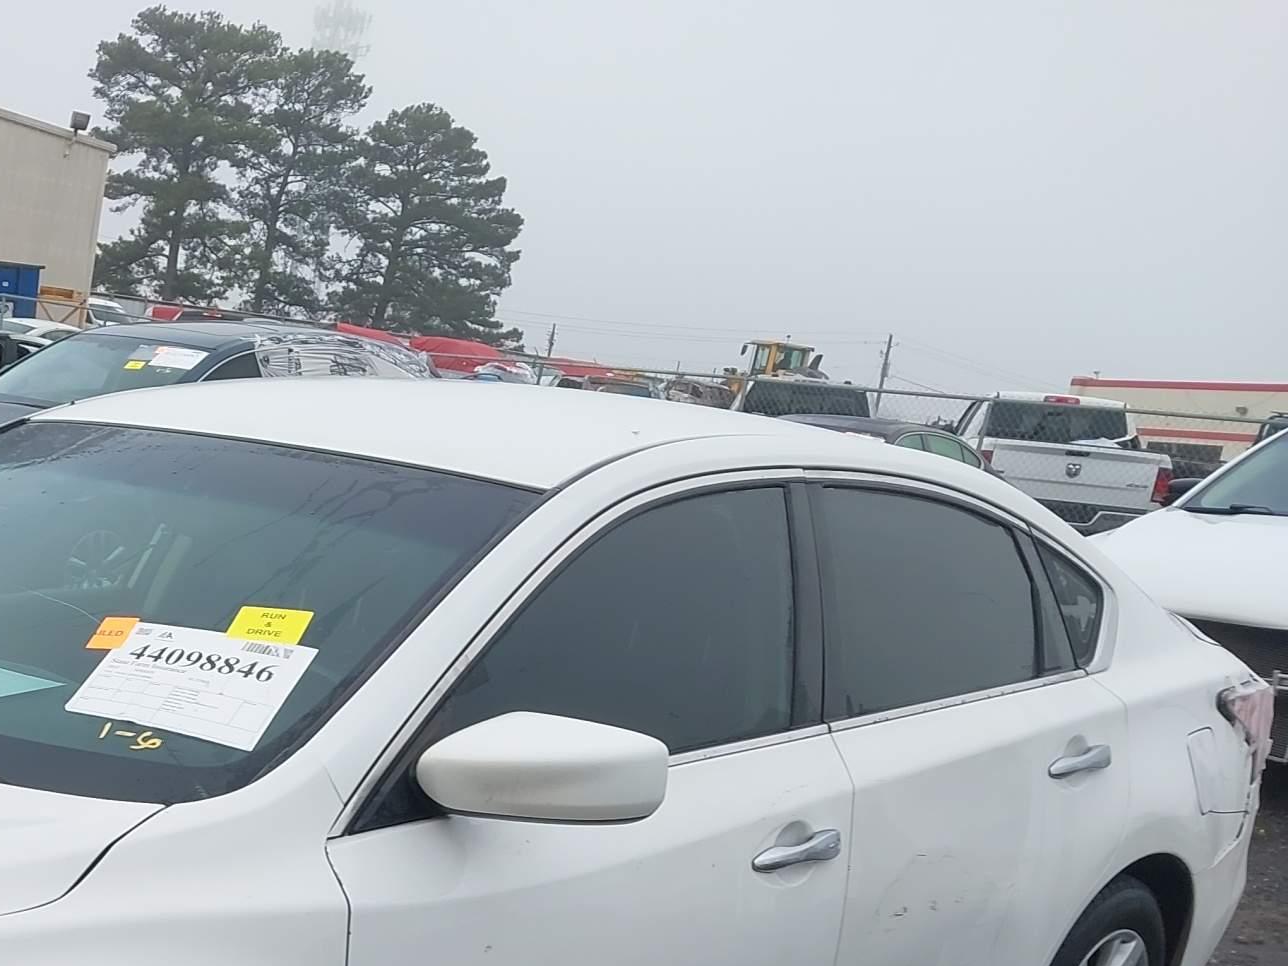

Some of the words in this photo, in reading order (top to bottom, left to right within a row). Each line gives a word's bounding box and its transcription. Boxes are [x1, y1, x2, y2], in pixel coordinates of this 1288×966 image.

[260, 612, 287, 620] RUN
[245, 628, 283, 638] DRIVE
[129, 644, 281, 682] 44098846
